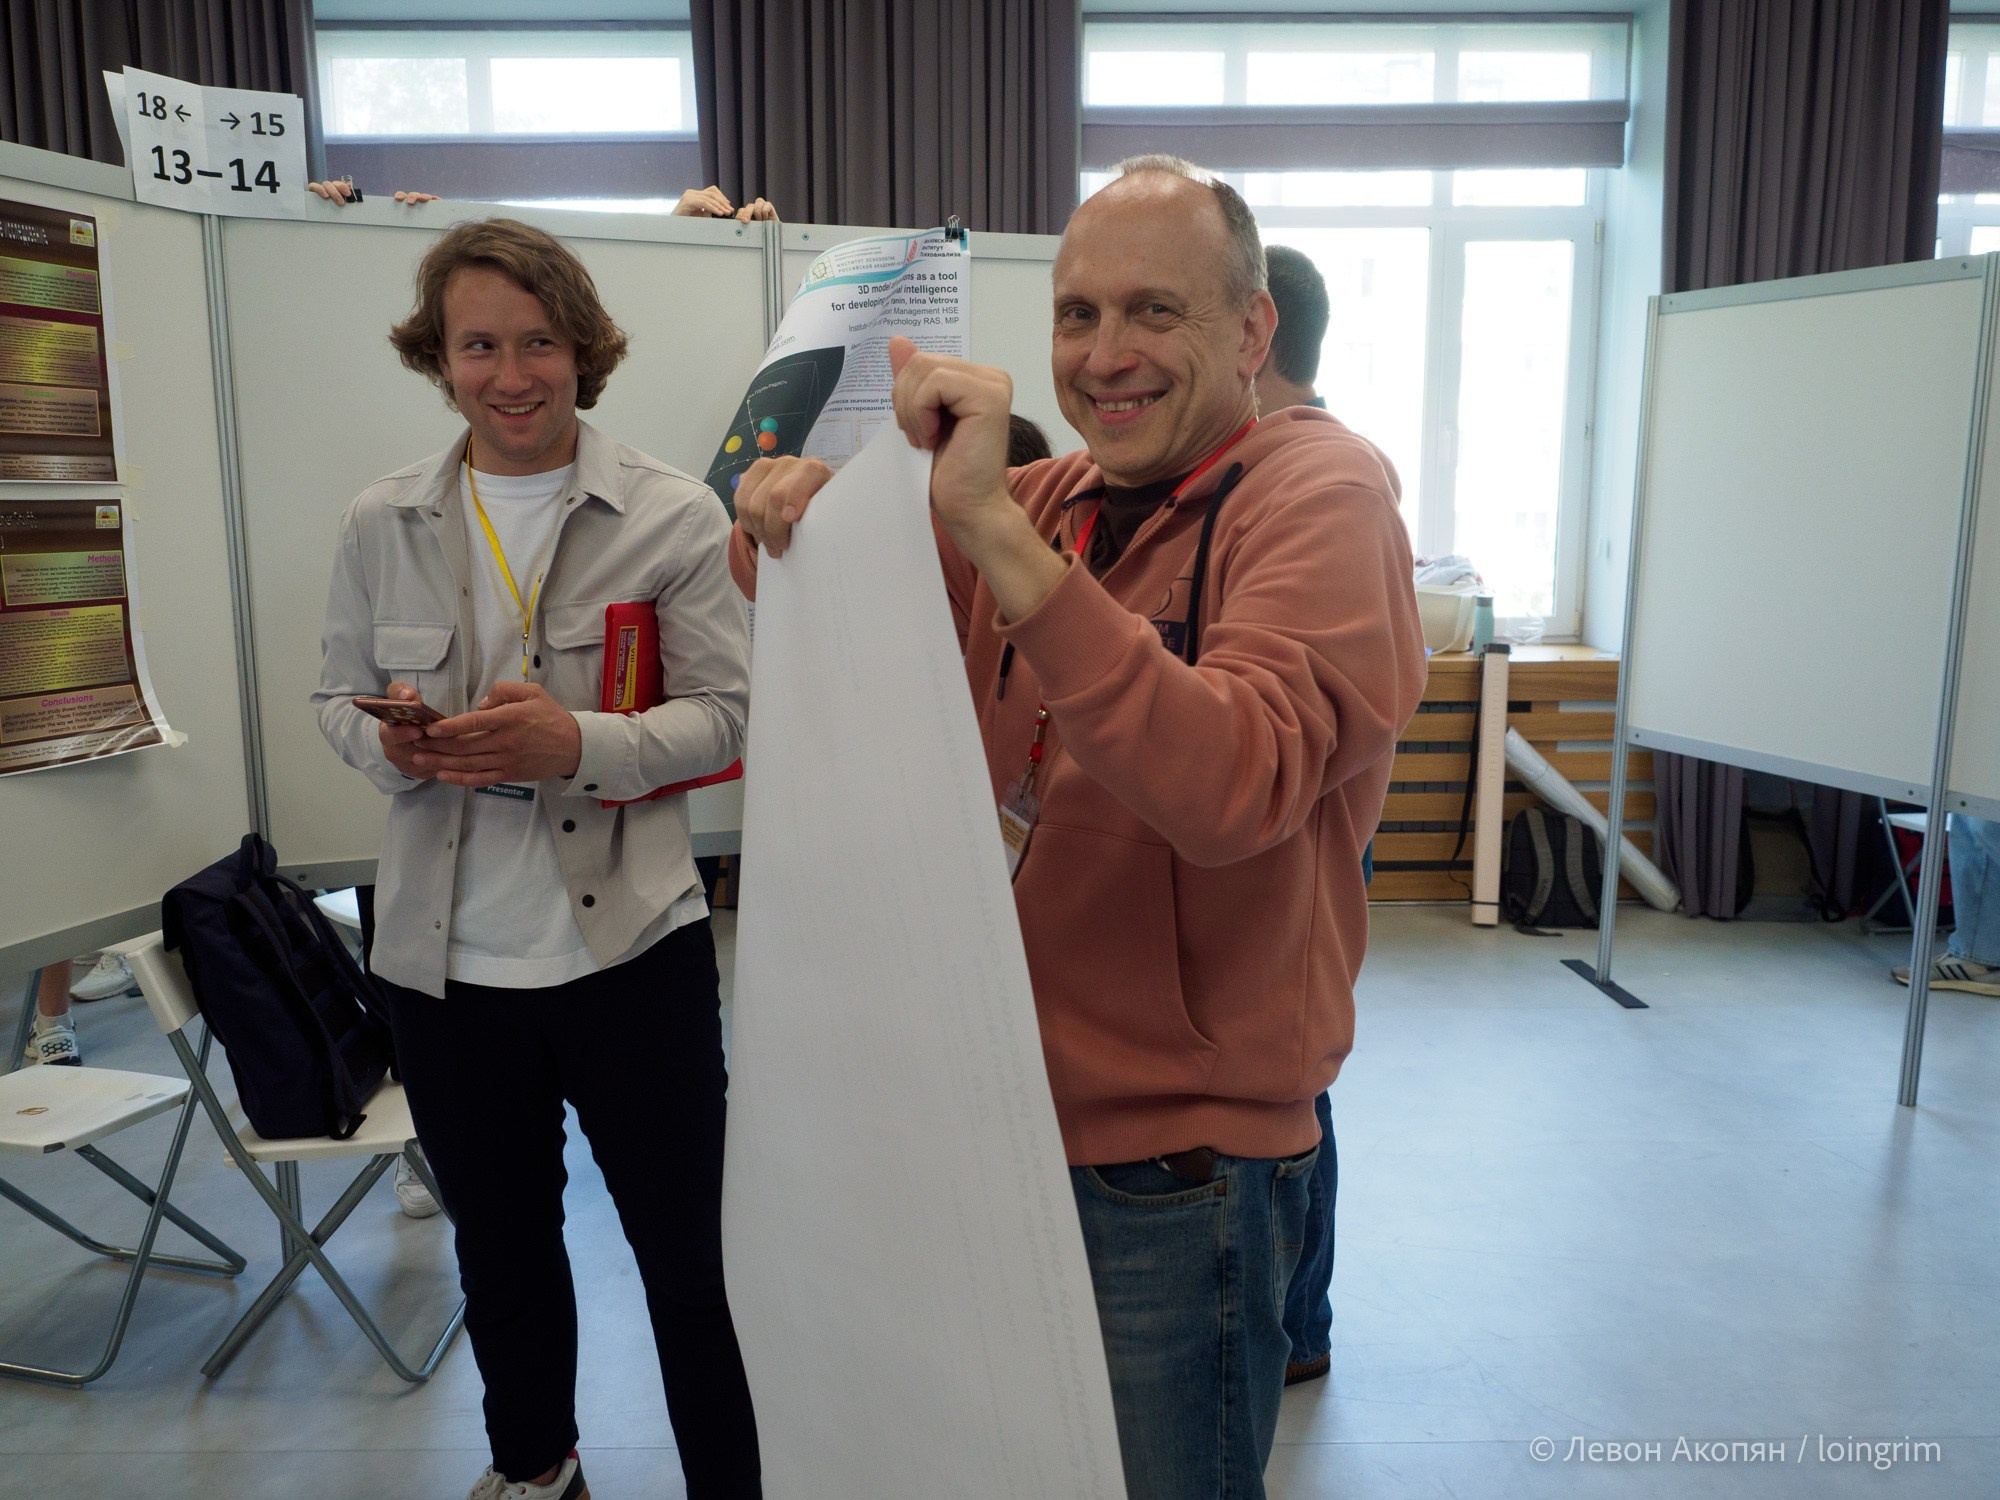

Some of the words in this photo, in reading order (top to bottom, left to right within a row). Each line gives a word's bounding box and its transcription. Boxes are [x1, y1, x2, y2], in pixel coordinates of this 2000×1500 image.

[137, 91, 167, 120] 18
[250, 111, 285, 136] 15
[858, 284, 870, 294] 3D
[938, 272, 958, 280] tool
[832, 302, 846, 311] for
[904, 284, 958, 296] intelligence
[894, 307, 940, 316] Management
[882, 317, 922, 326] Psychology
[88, 554, 120, 562] Methods
[42, 695, 94, 707] Conclusions
[488, 784, 525, 796] Presenter
